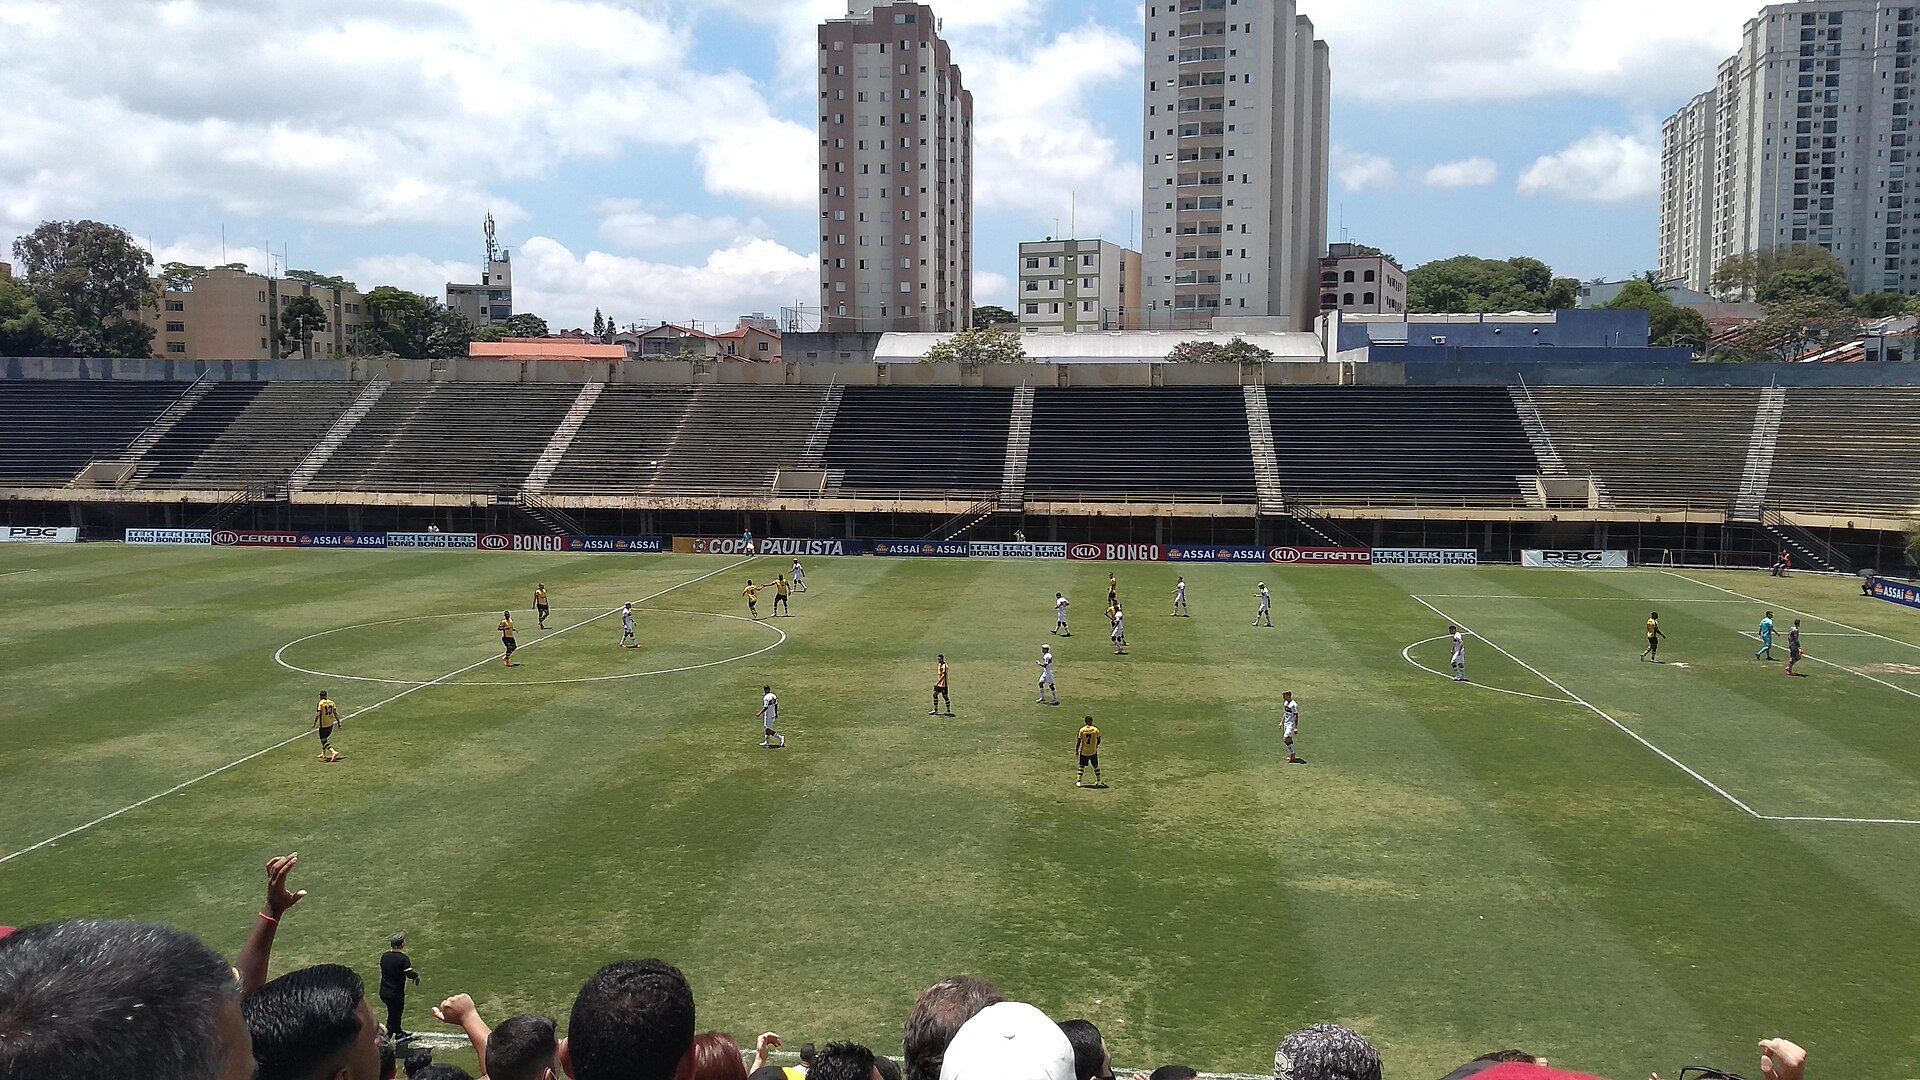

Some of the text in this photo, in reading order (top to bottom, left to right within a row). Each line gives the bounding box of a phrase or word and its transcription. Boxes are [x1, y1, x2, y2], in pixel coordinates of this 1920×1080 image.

[10, 528, 58, 536] PBG
[240, 534, 297, 543] CERATO
[313, 536, 342, 544] ASSAÍ
[356, 536, 386, 544] ASSAÍ
[514, 534, 562, 550] BONGO
[584, 540, 614, 549] ASSAÍ
[630, 540, 660, 549] ASSAÍ
[760, 540, 844, 554] PAULISTA
[890, 544, 920, 554] ASSAÍ
[936, 545, 966, 554] ASSAÍ
[1106, 544, 1159, 560] BONGO
[1183, 550, 1216, 558] ASSAÍ
[1232, 550, 1266, 558] ASSAÍ
[1301, 552, 1370, 560] CERATO
[1542, 551, 1602, 560] PBG
[1884, 586, 1904, 600] ASSAÍ
[1086, 734, 1092, 744] 7
